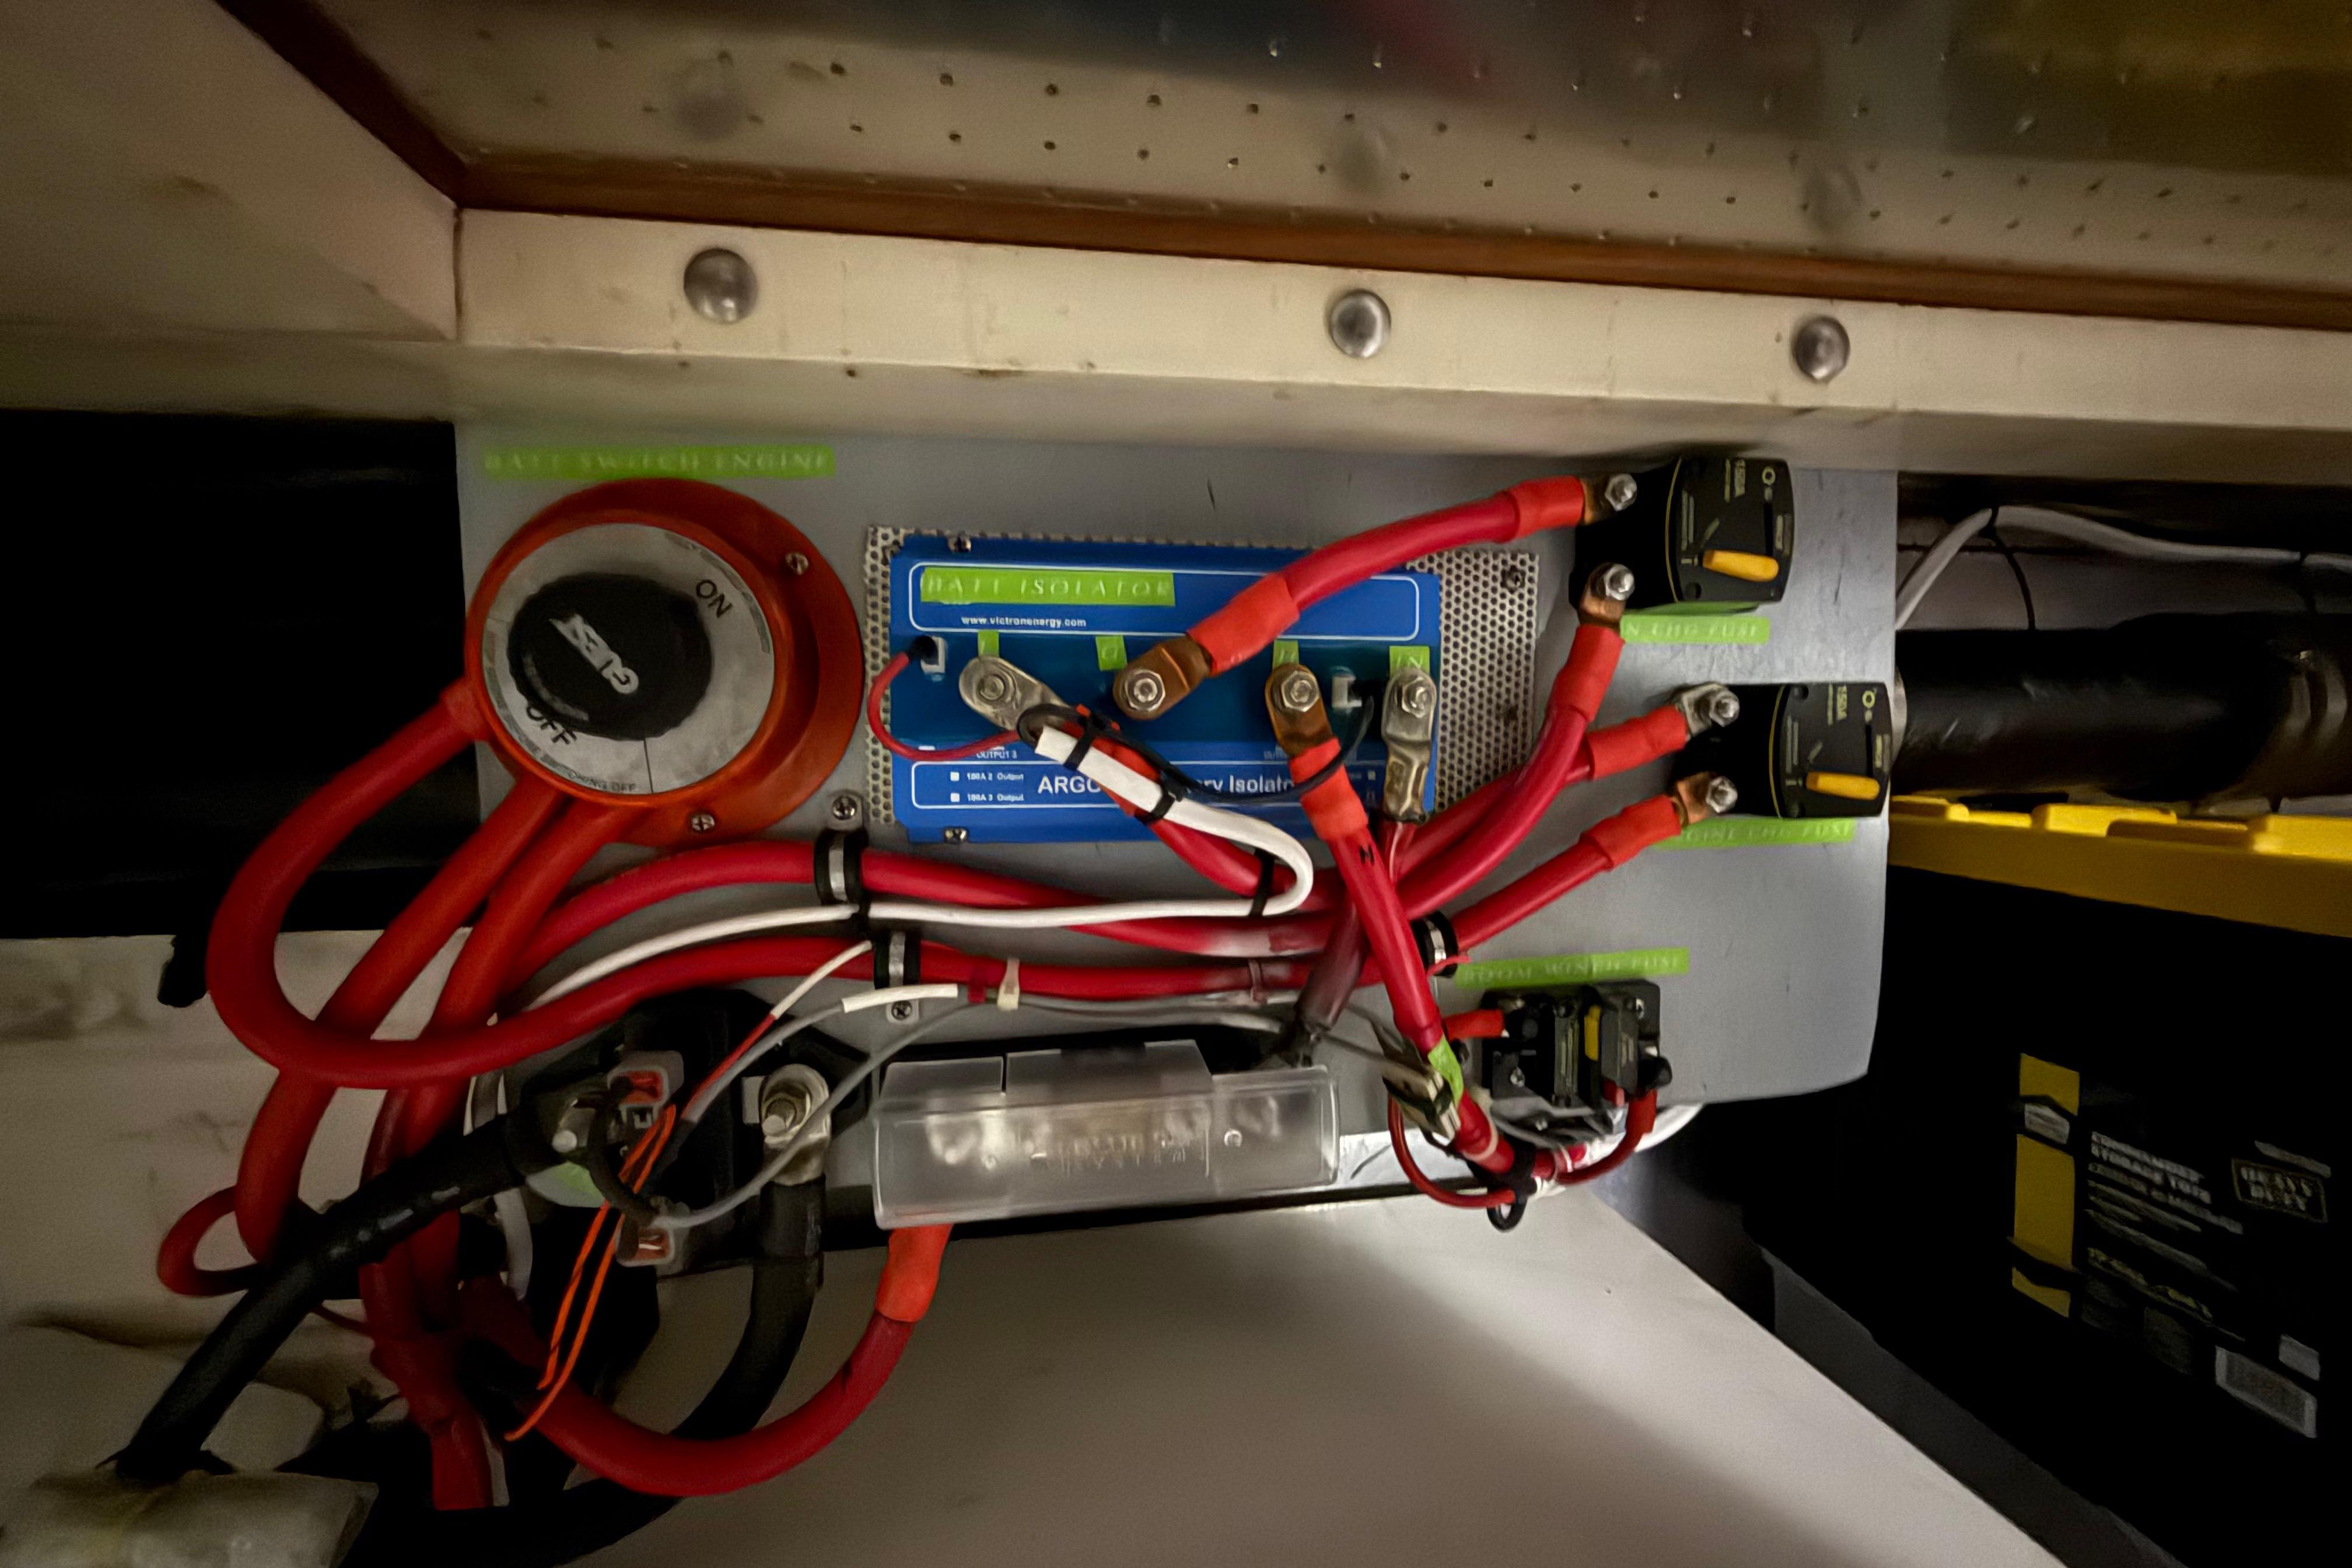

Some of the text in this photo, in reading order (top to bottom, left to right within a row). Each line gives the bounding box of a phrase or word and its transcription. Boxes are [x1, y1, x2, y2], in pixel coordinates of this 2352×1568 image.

[715, 453, 826, 471] ENGINE
[926, 576, 1171, 598] BATT ISOLATOR
[695, 579, 733, 618] ON
[961, 615, 1087, 628] www.victronenergy.com
[526, 704, 577, 745] OFF
[976, 750, 1010, 759] OUTPUT
